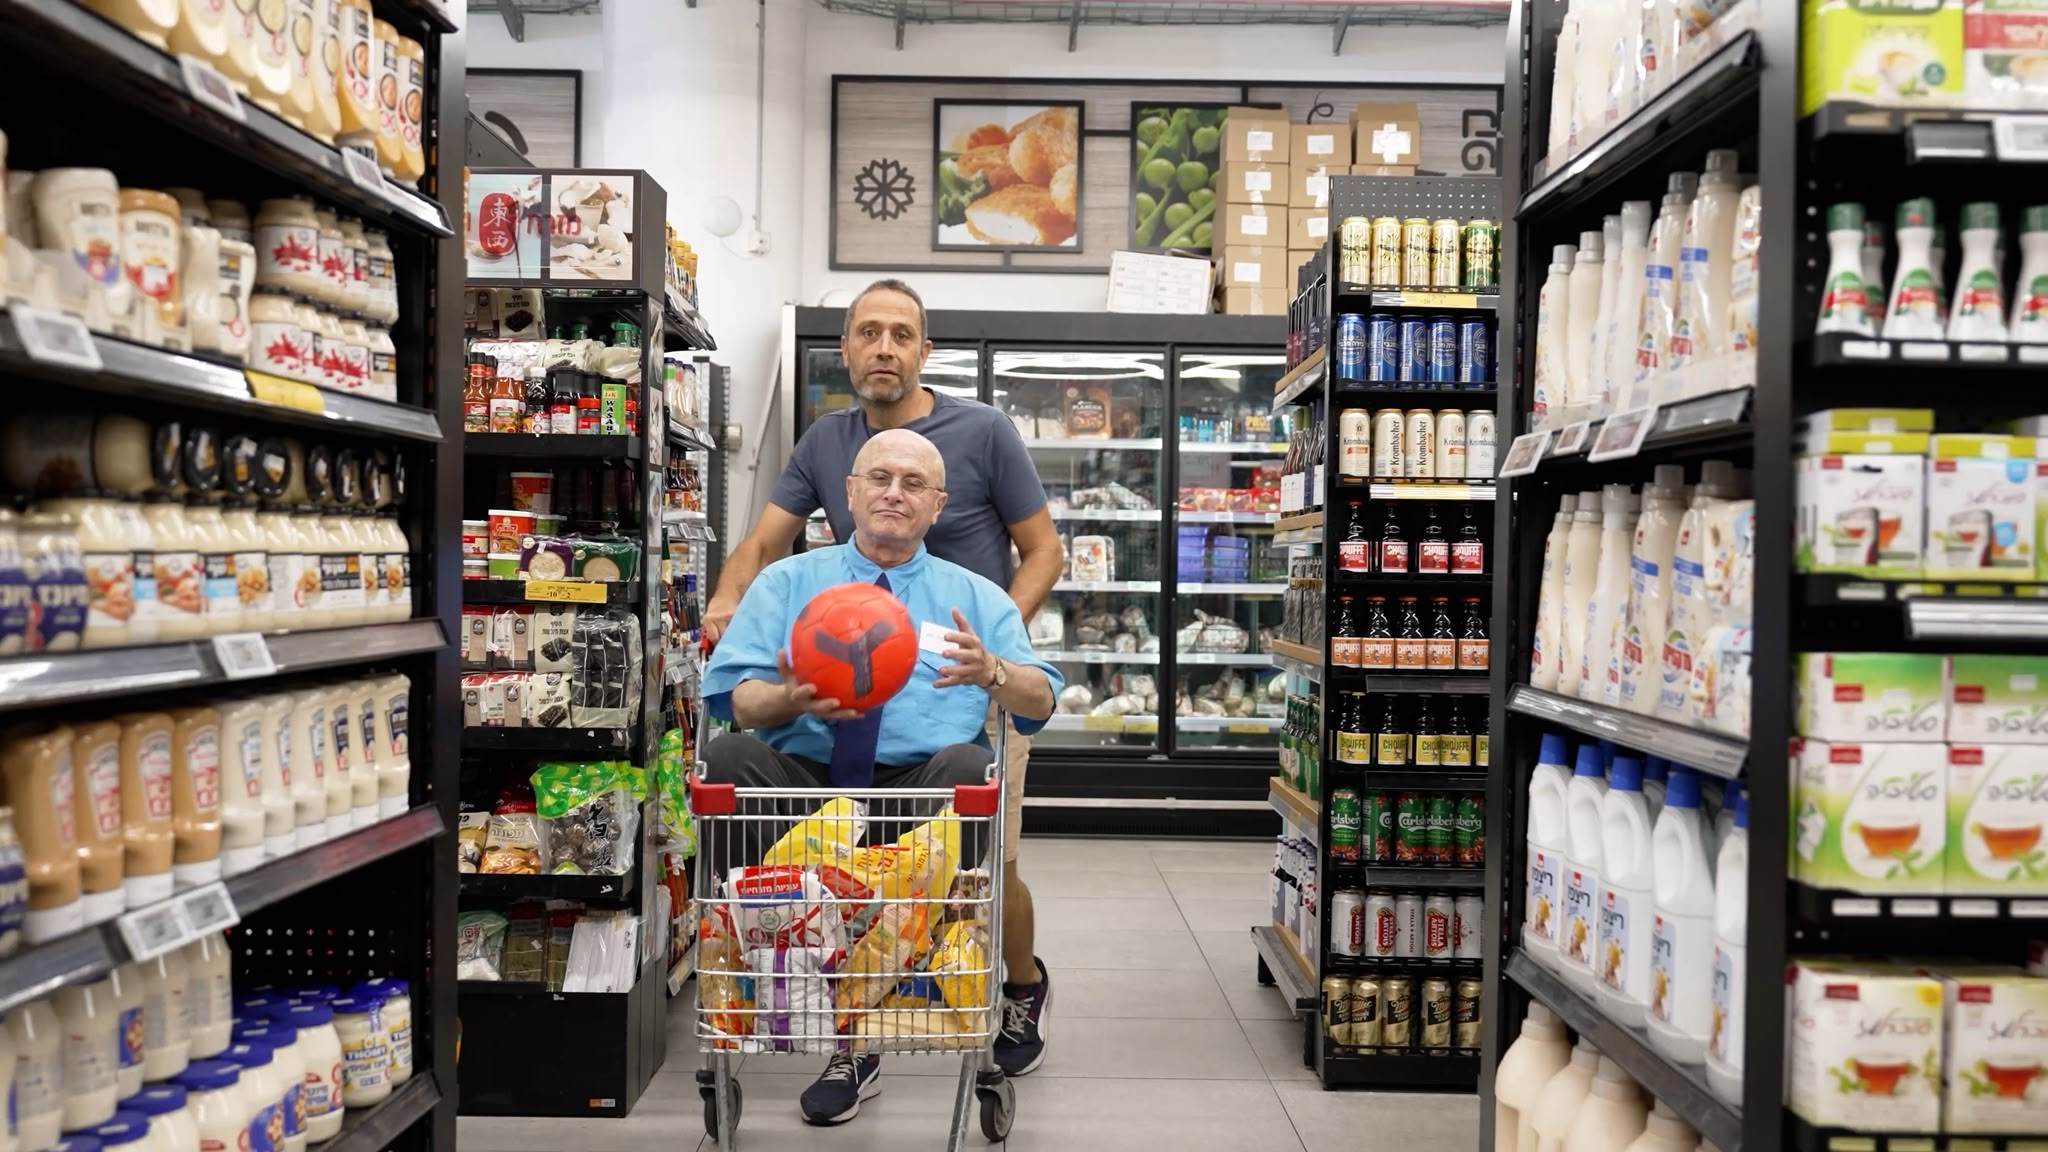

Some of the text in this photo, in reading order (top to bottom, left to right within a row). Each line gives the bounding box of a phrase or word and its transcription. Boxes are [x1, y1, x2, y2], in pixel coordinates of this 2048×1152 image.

[1390, 420, 1401, 466] Krombacher
[1417, 421, 1428, 466] Krombacher
[1437, 918, 1445, 948] STELLA
[346, 1047, 387, 1061] THOMY
